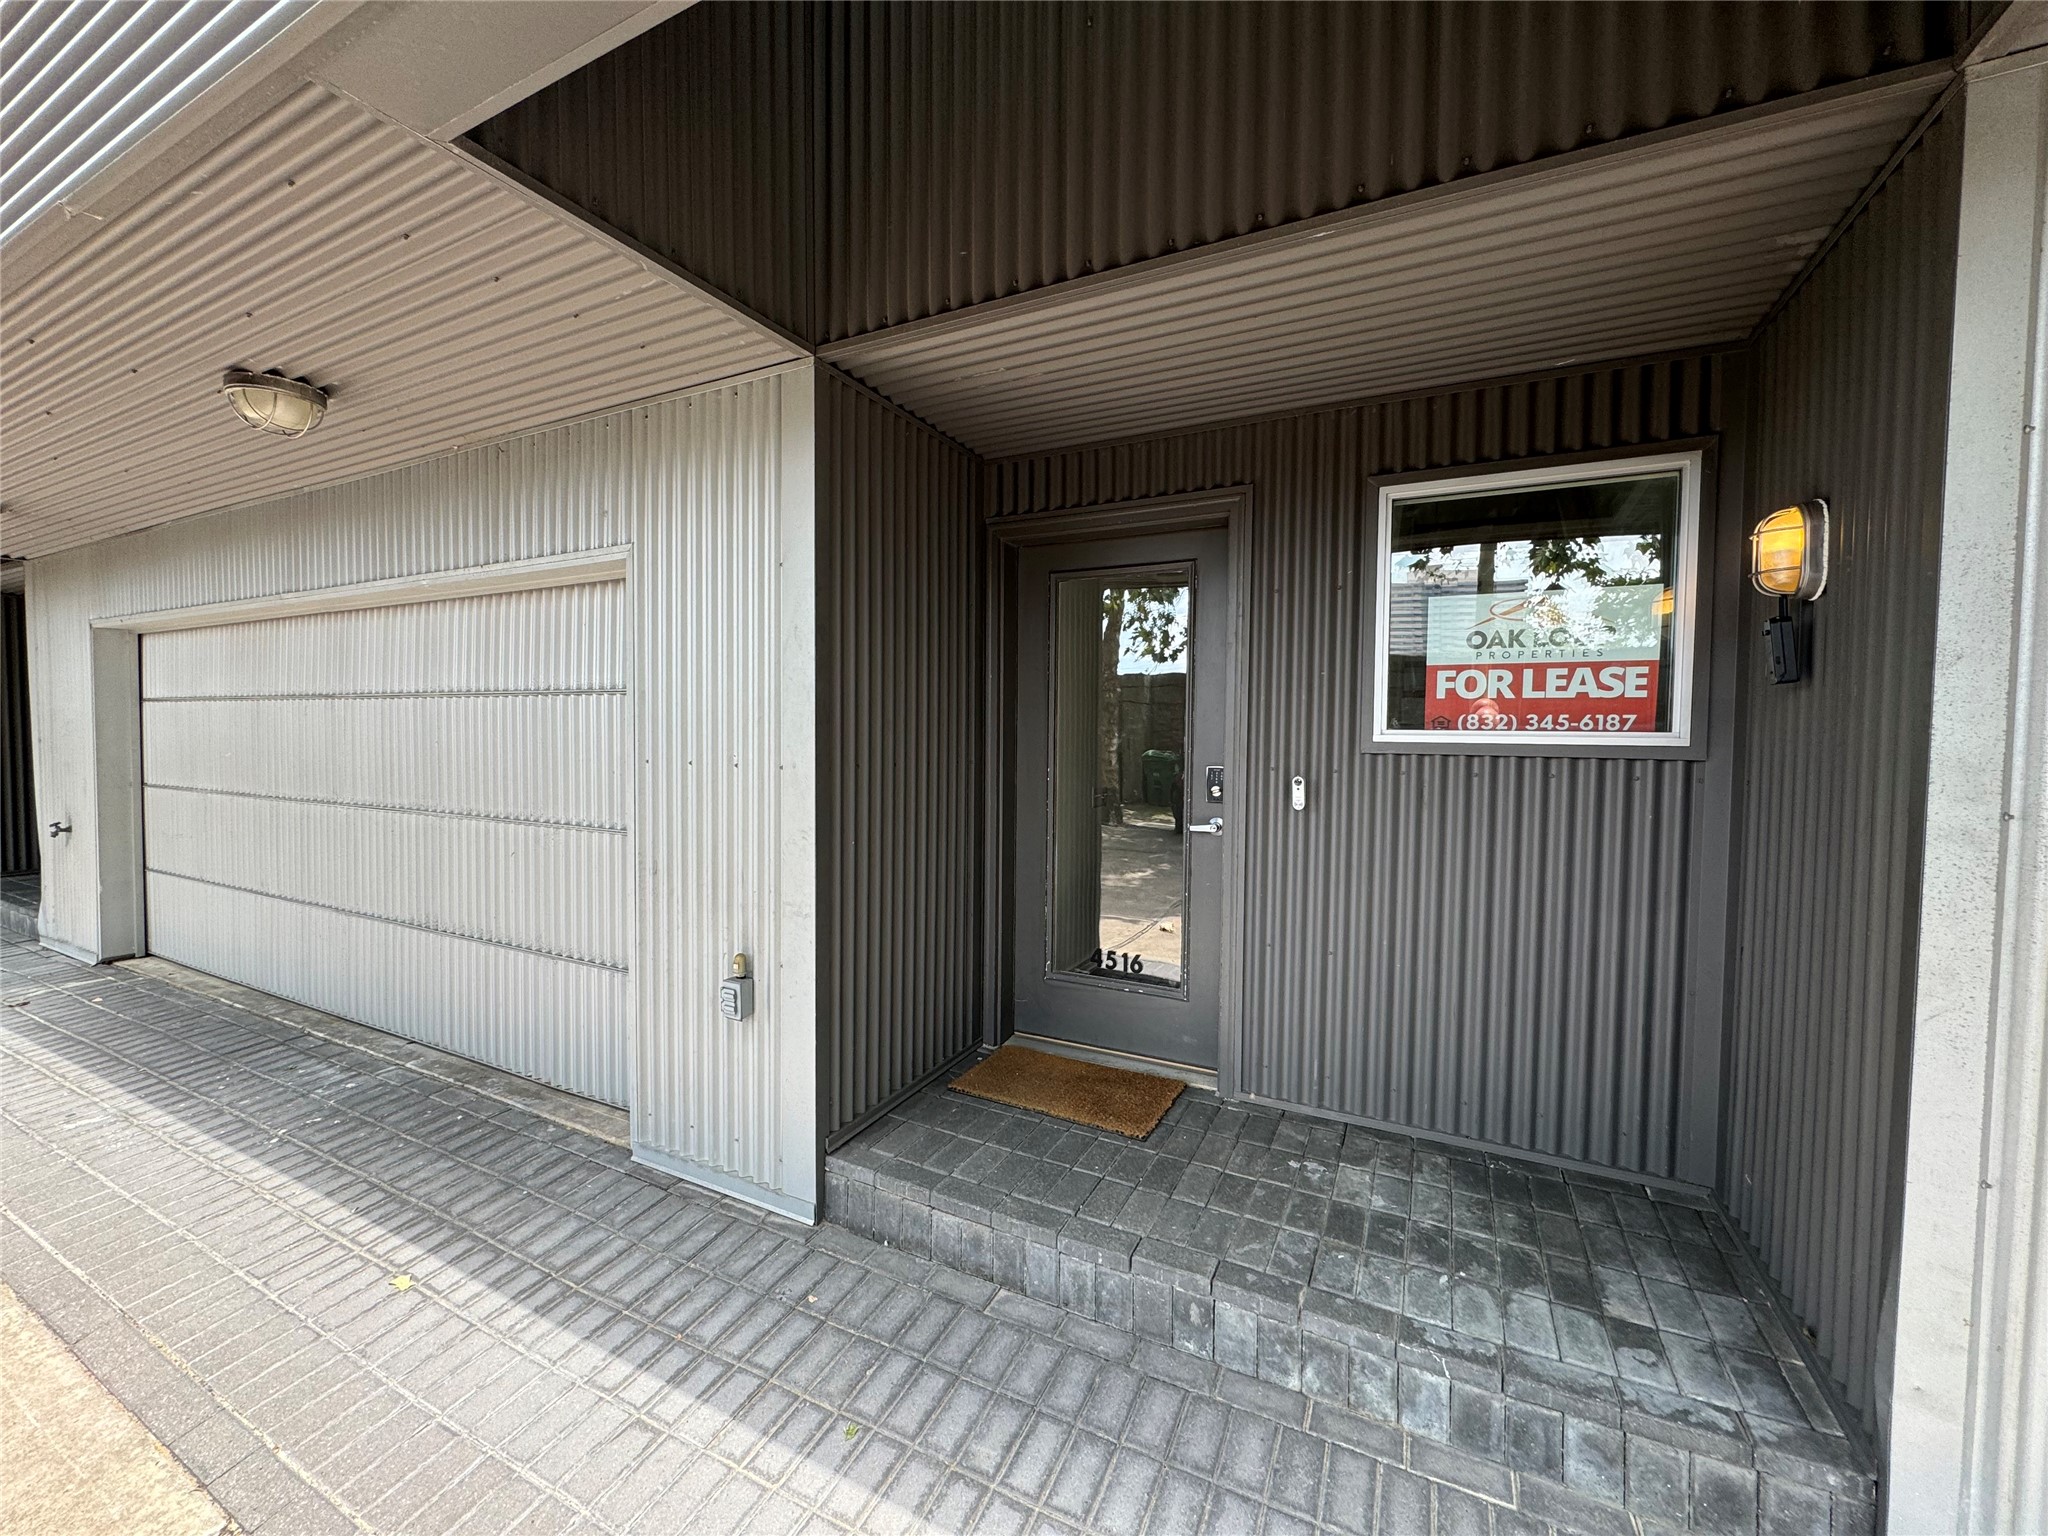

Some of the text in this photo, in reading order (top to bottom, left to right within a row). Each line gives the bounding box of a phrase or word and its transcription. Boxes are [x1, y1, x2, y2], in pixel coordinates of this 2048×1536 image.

[1465, 628, 1527, 650] OAK
[1475, 648, 1604, 660] PROPERTIES
[1436, 666, 1650, 700] FOR LEASE
[1457, 713, 1638, 731] (832) 345-6187
[1090, 947, 1144, 974] 4516
